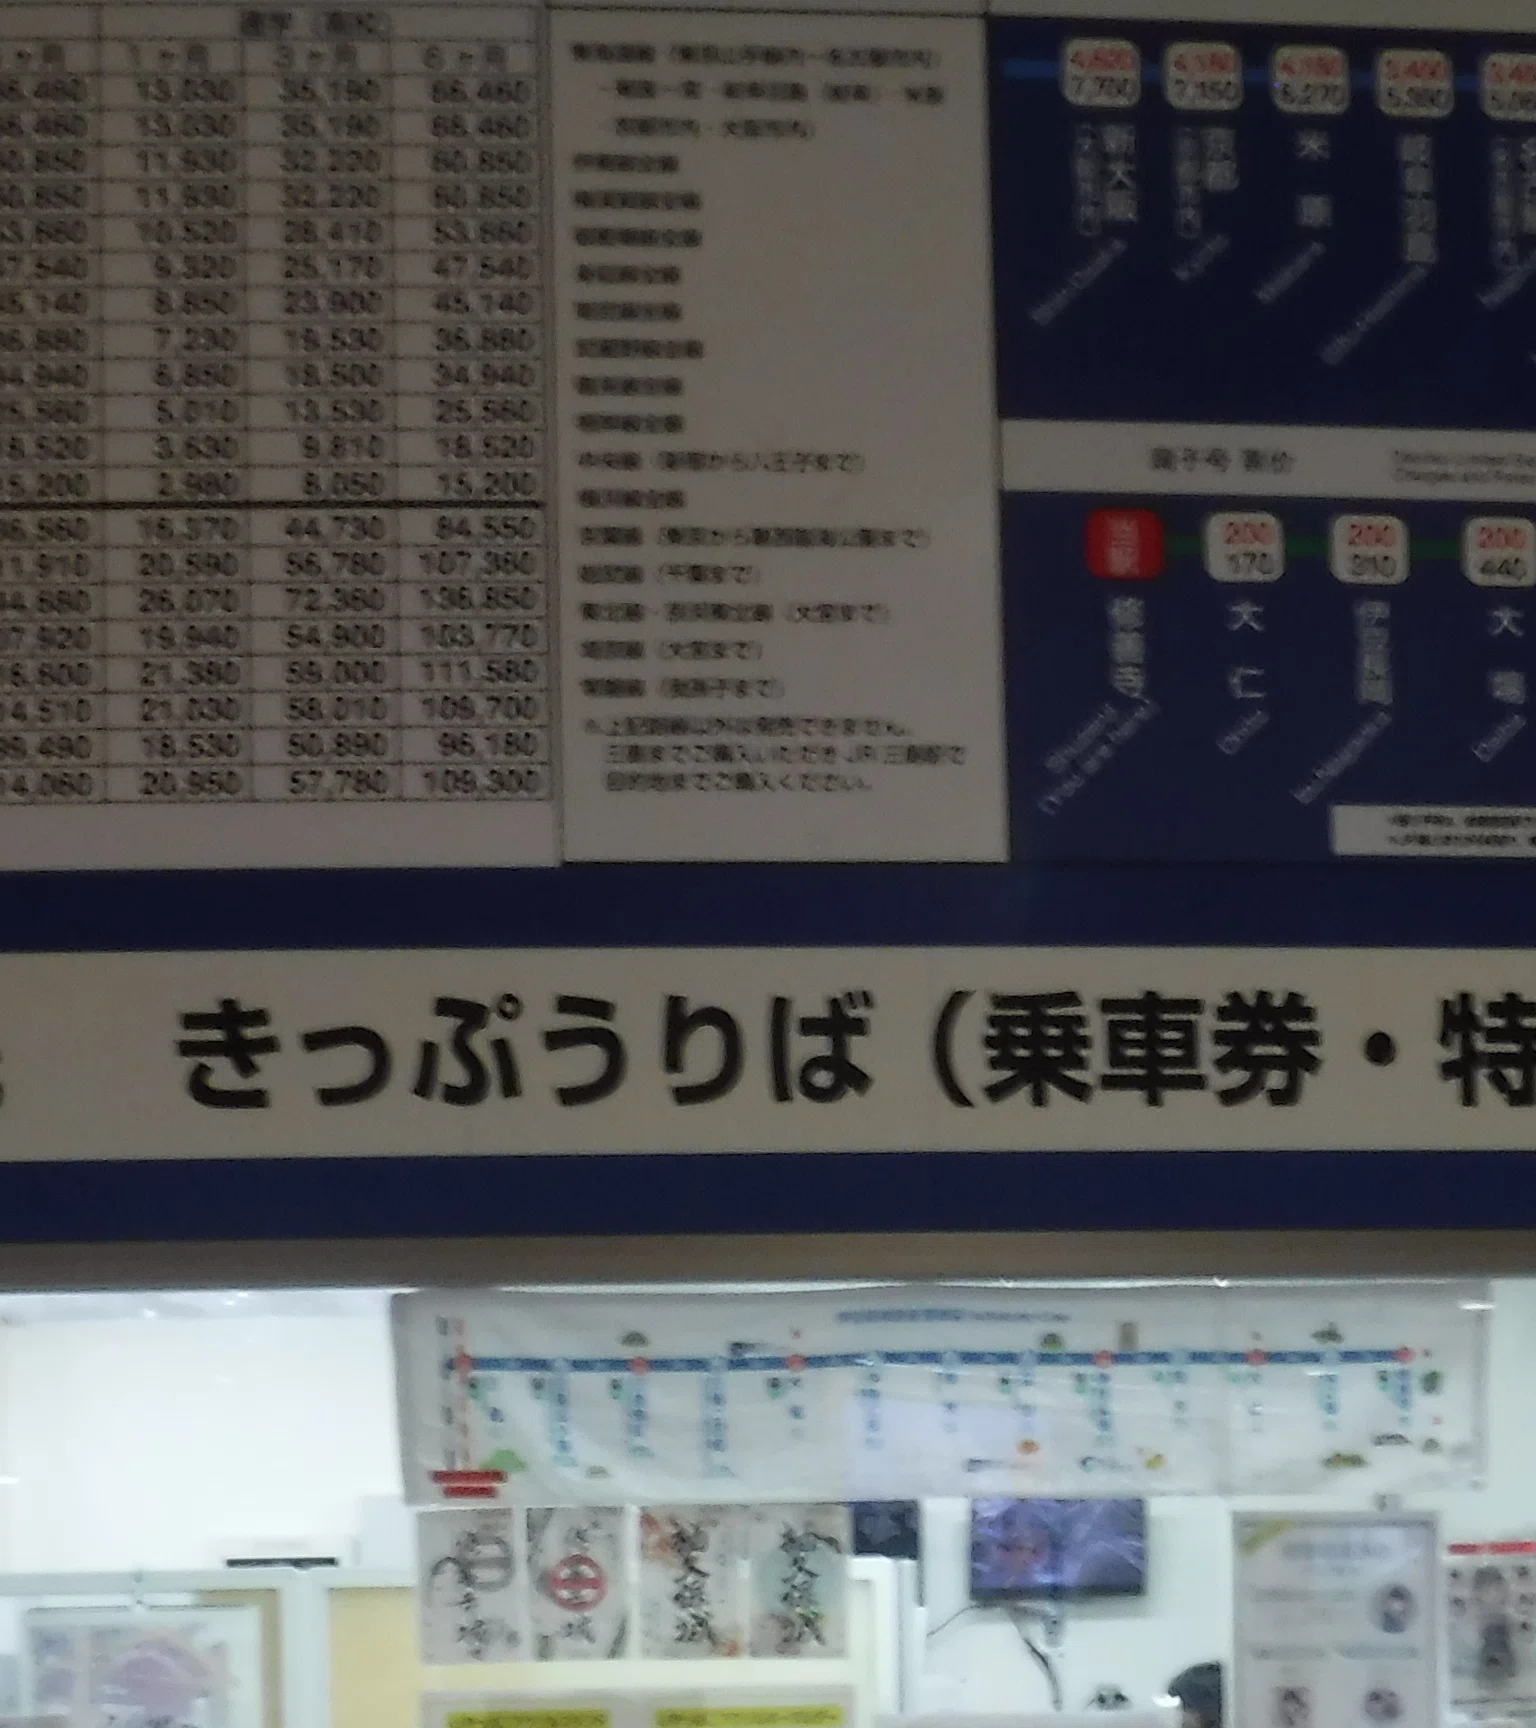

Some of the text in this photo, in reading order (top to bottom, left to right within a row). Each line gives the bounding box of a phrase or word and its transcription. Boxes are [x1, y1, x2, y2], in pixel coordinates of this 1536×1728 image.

[1223, 521, 1272, 547] 200
[1346, 523, 1397, 548] 200
[1477, 526, 1526, 551] 200
